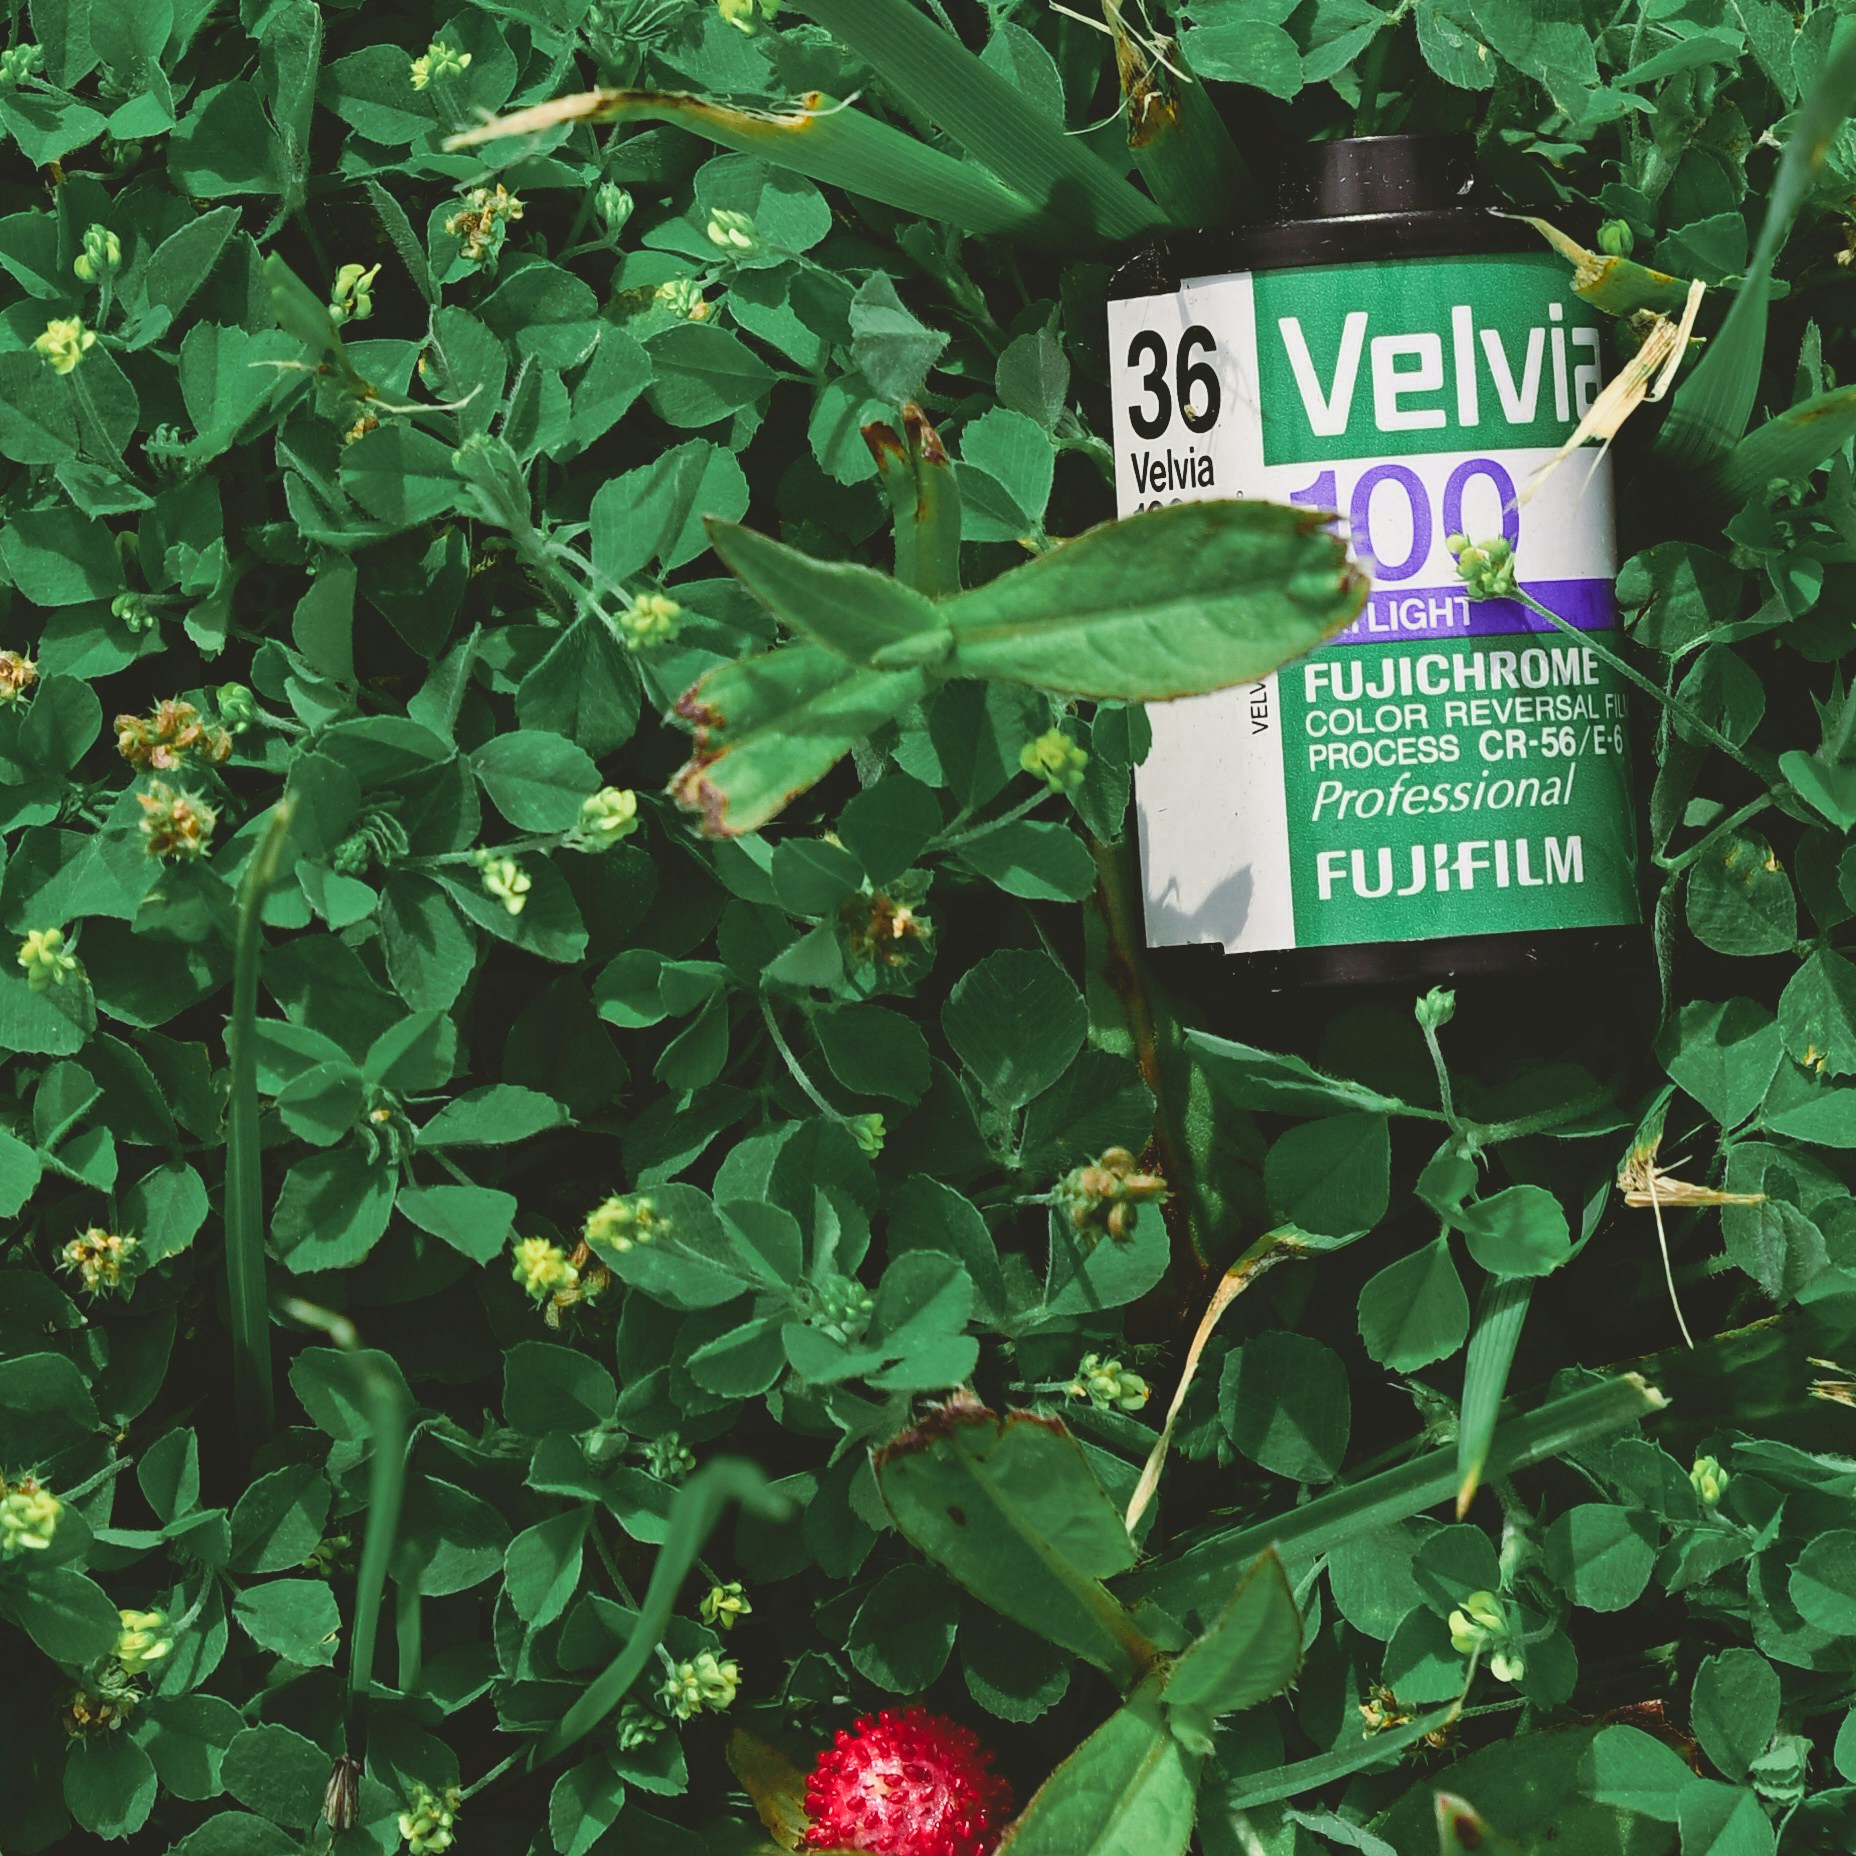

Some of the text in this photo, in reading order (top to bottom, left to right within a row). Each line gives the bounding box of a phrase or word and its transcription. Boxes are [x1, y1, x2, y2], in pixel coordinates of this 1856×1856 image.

[1126, 325, 1221, 441] 36
[1278, 303, 1601, 436] Velvia
[1131, 446, 1214, 494] Velvia
[1304, 647, 1599, 702] FUJICHROME
[1305, 704, 1428, 737] COLOR
[1445, 694, 1599, 728] REVERSAL
[1309, 734, 1459, 771] PROCESS
[1312, 762, 1575, 822] Professional
[1317, 835, 1584, 900] FUJIFILM
